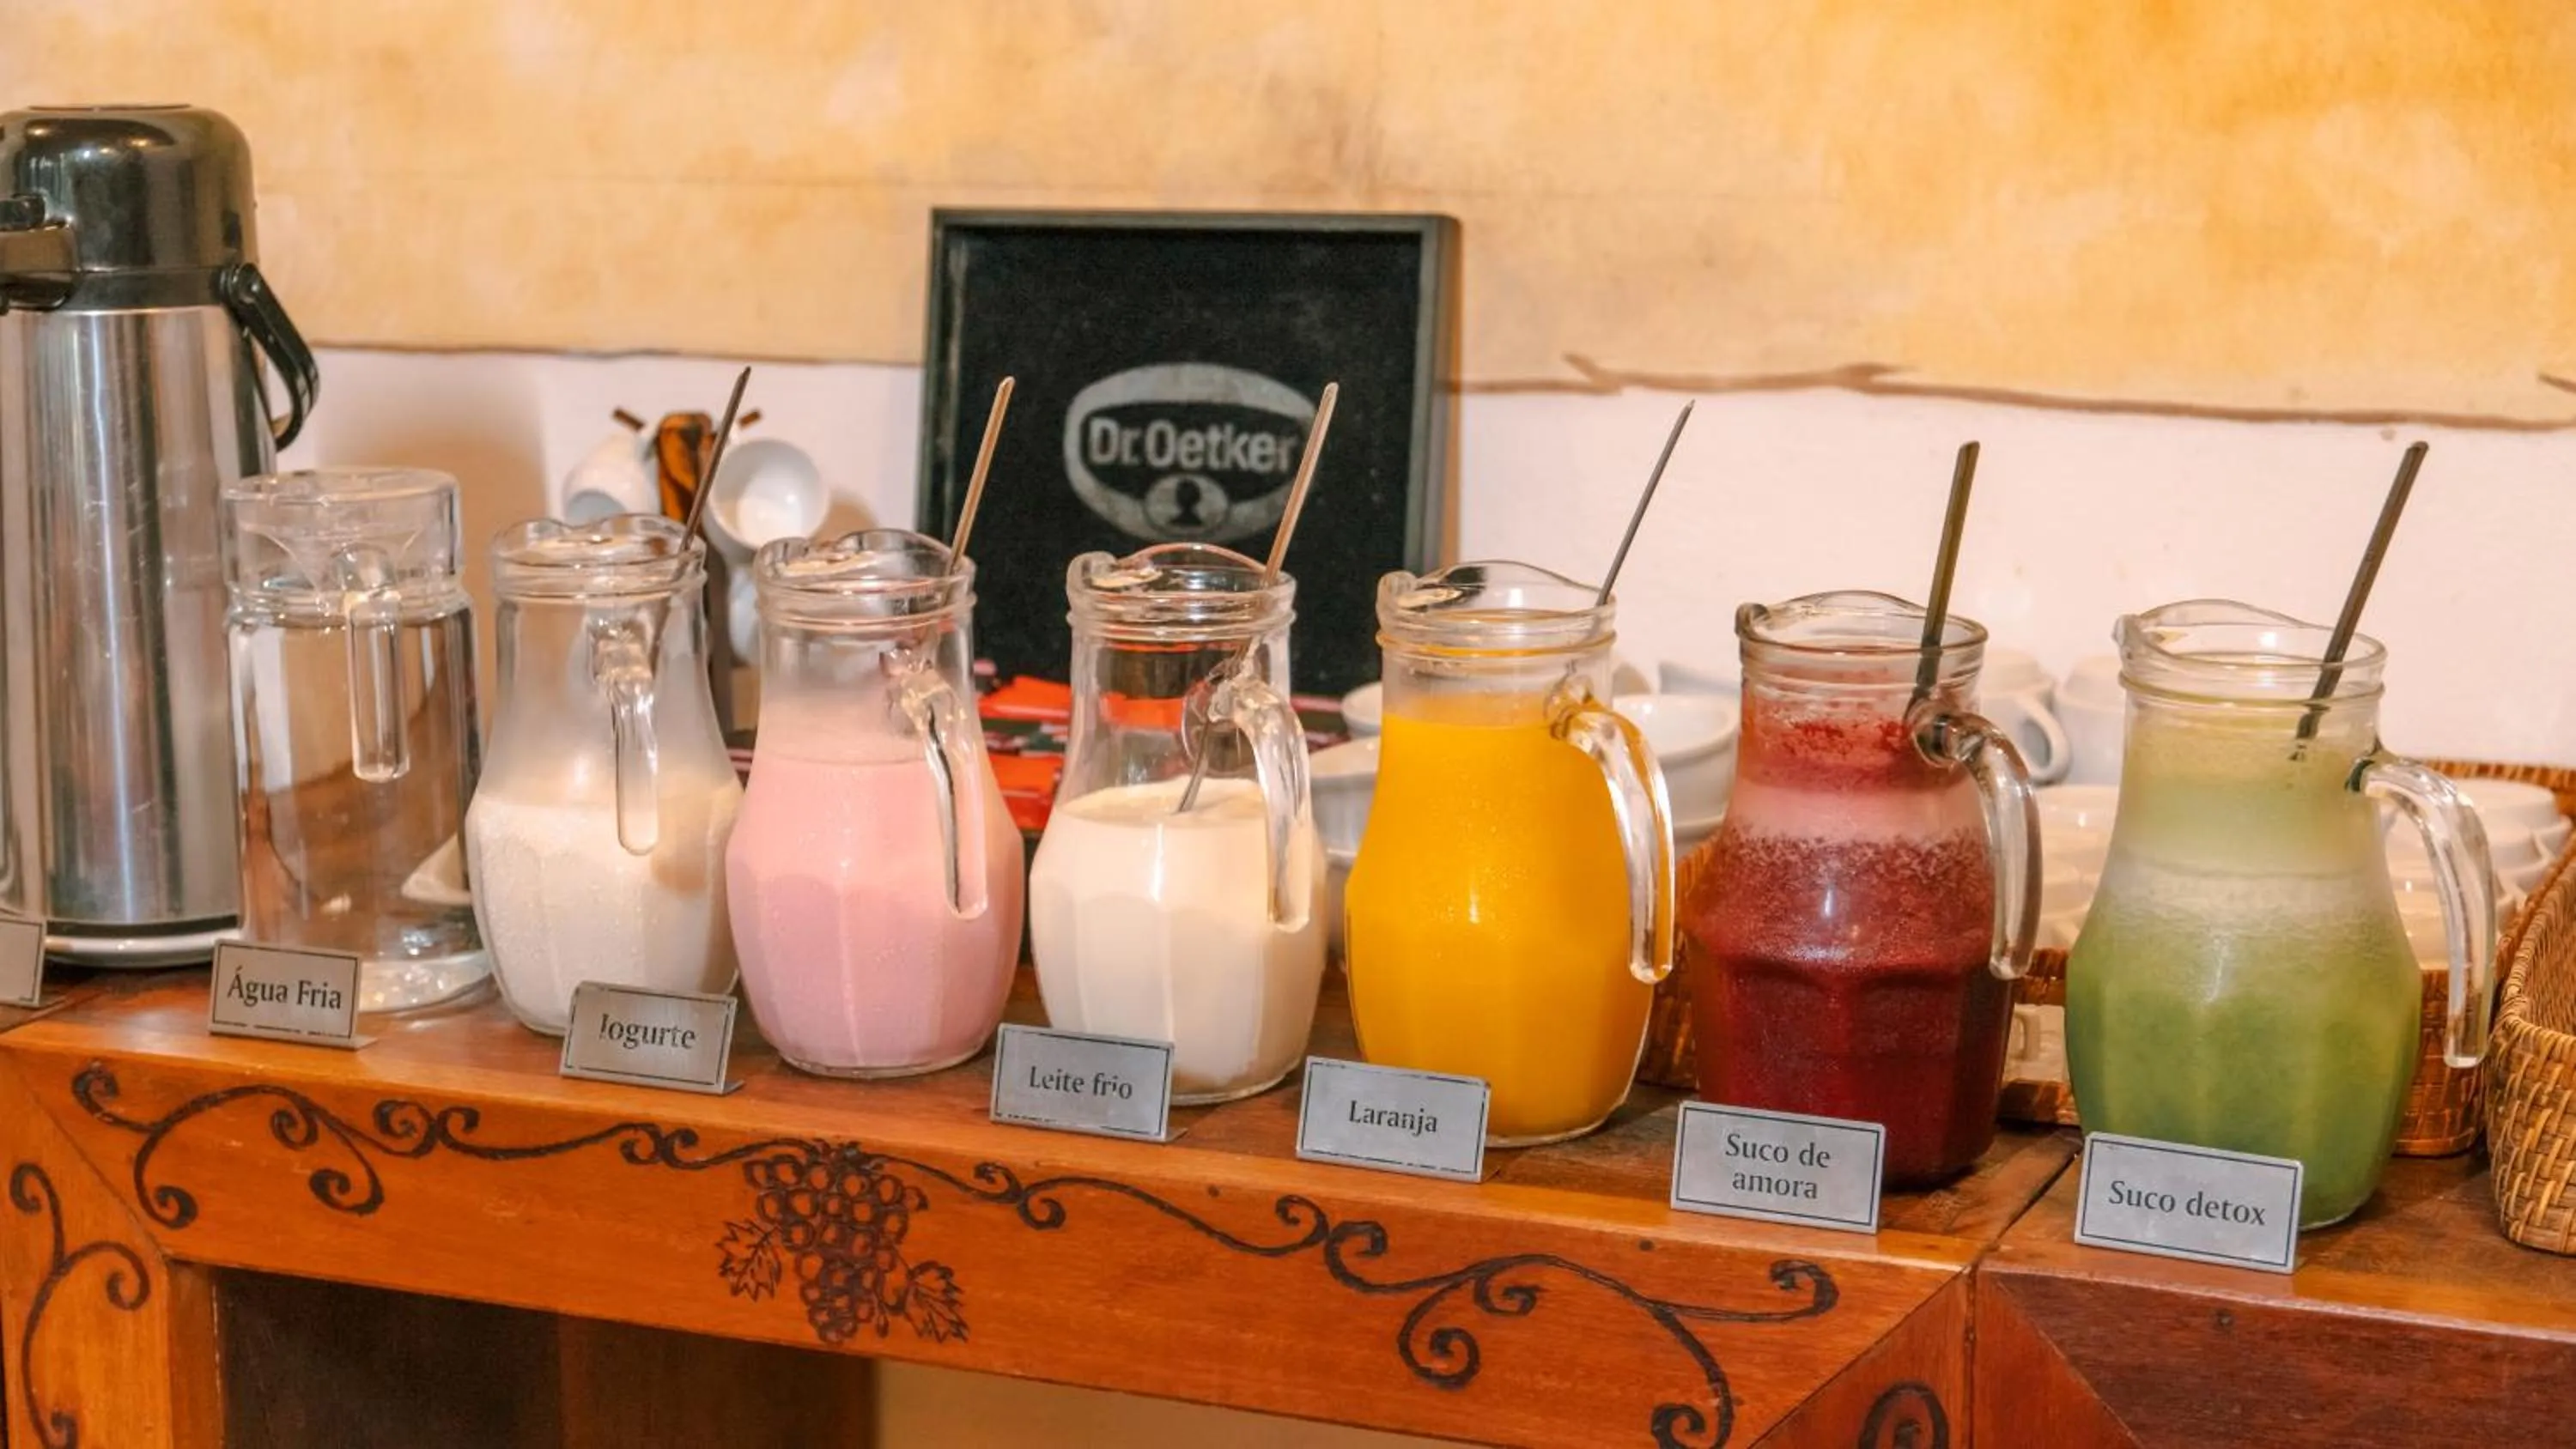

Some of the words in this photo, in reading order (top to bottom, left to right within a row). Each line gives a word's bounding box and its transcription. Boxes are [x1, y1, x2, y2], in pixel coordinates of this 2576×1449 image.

[227, 965, 288, 1007] Água
[295, 979, 342, 1009] Fria
[599, 1012, 696, 1050] Iogurte
[1030, 1065, 1085, 1094] Leite
[1092, 1072, 1133, 1100] frio
[1349, 1100, 1438, 1137] Laranja
[1725, 1133, 1789, 1163] Suco
[1799, 1142, 1832, 1168] de
[1732, 1171, 1818, 1199] amora
[2108, 1179, 2176, 1213] Suco
[2185, 1191, 2266, 1226] detox
